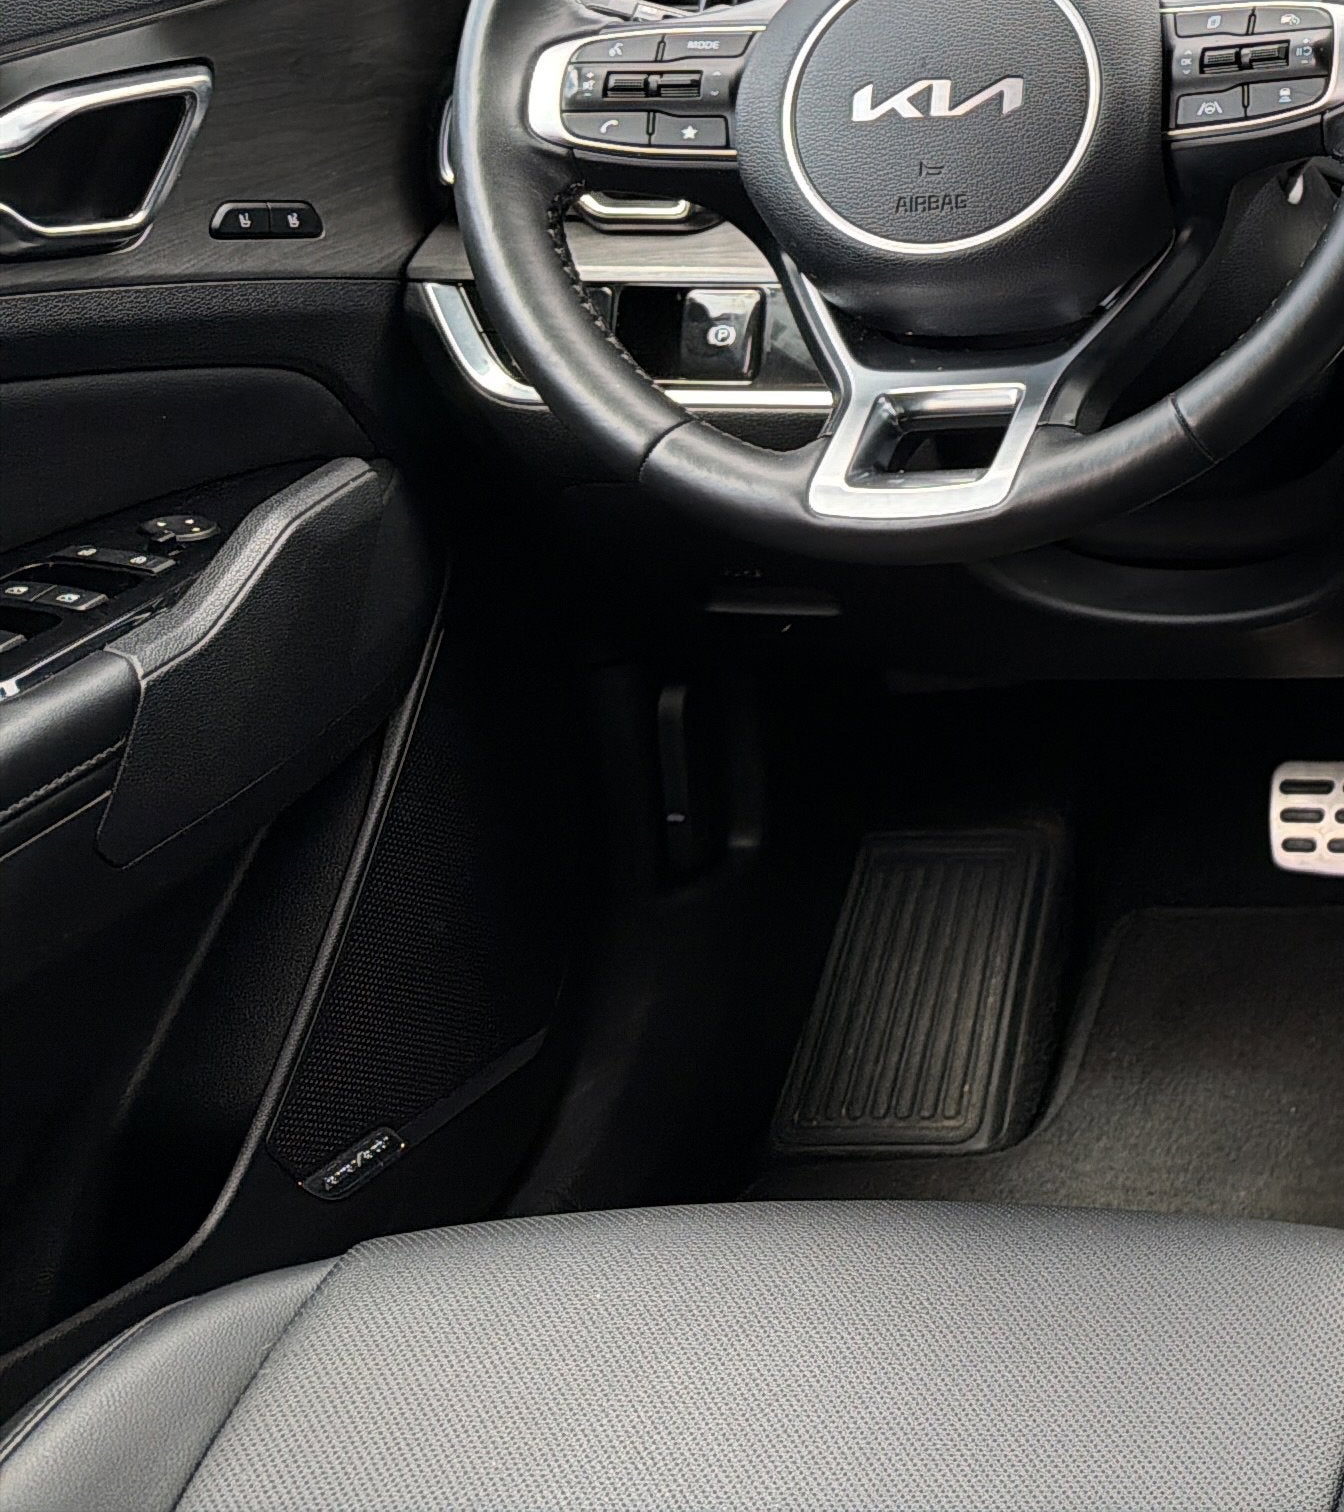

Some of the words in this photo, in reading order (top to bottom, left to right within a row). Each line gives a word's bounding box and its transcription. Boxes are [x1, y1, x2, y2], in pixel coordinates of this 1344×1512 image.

[687, 40, 720, 50] MODE
[851, 76, 1025, 124] KIA
[894, 192, 968, 215] AIRBAG
